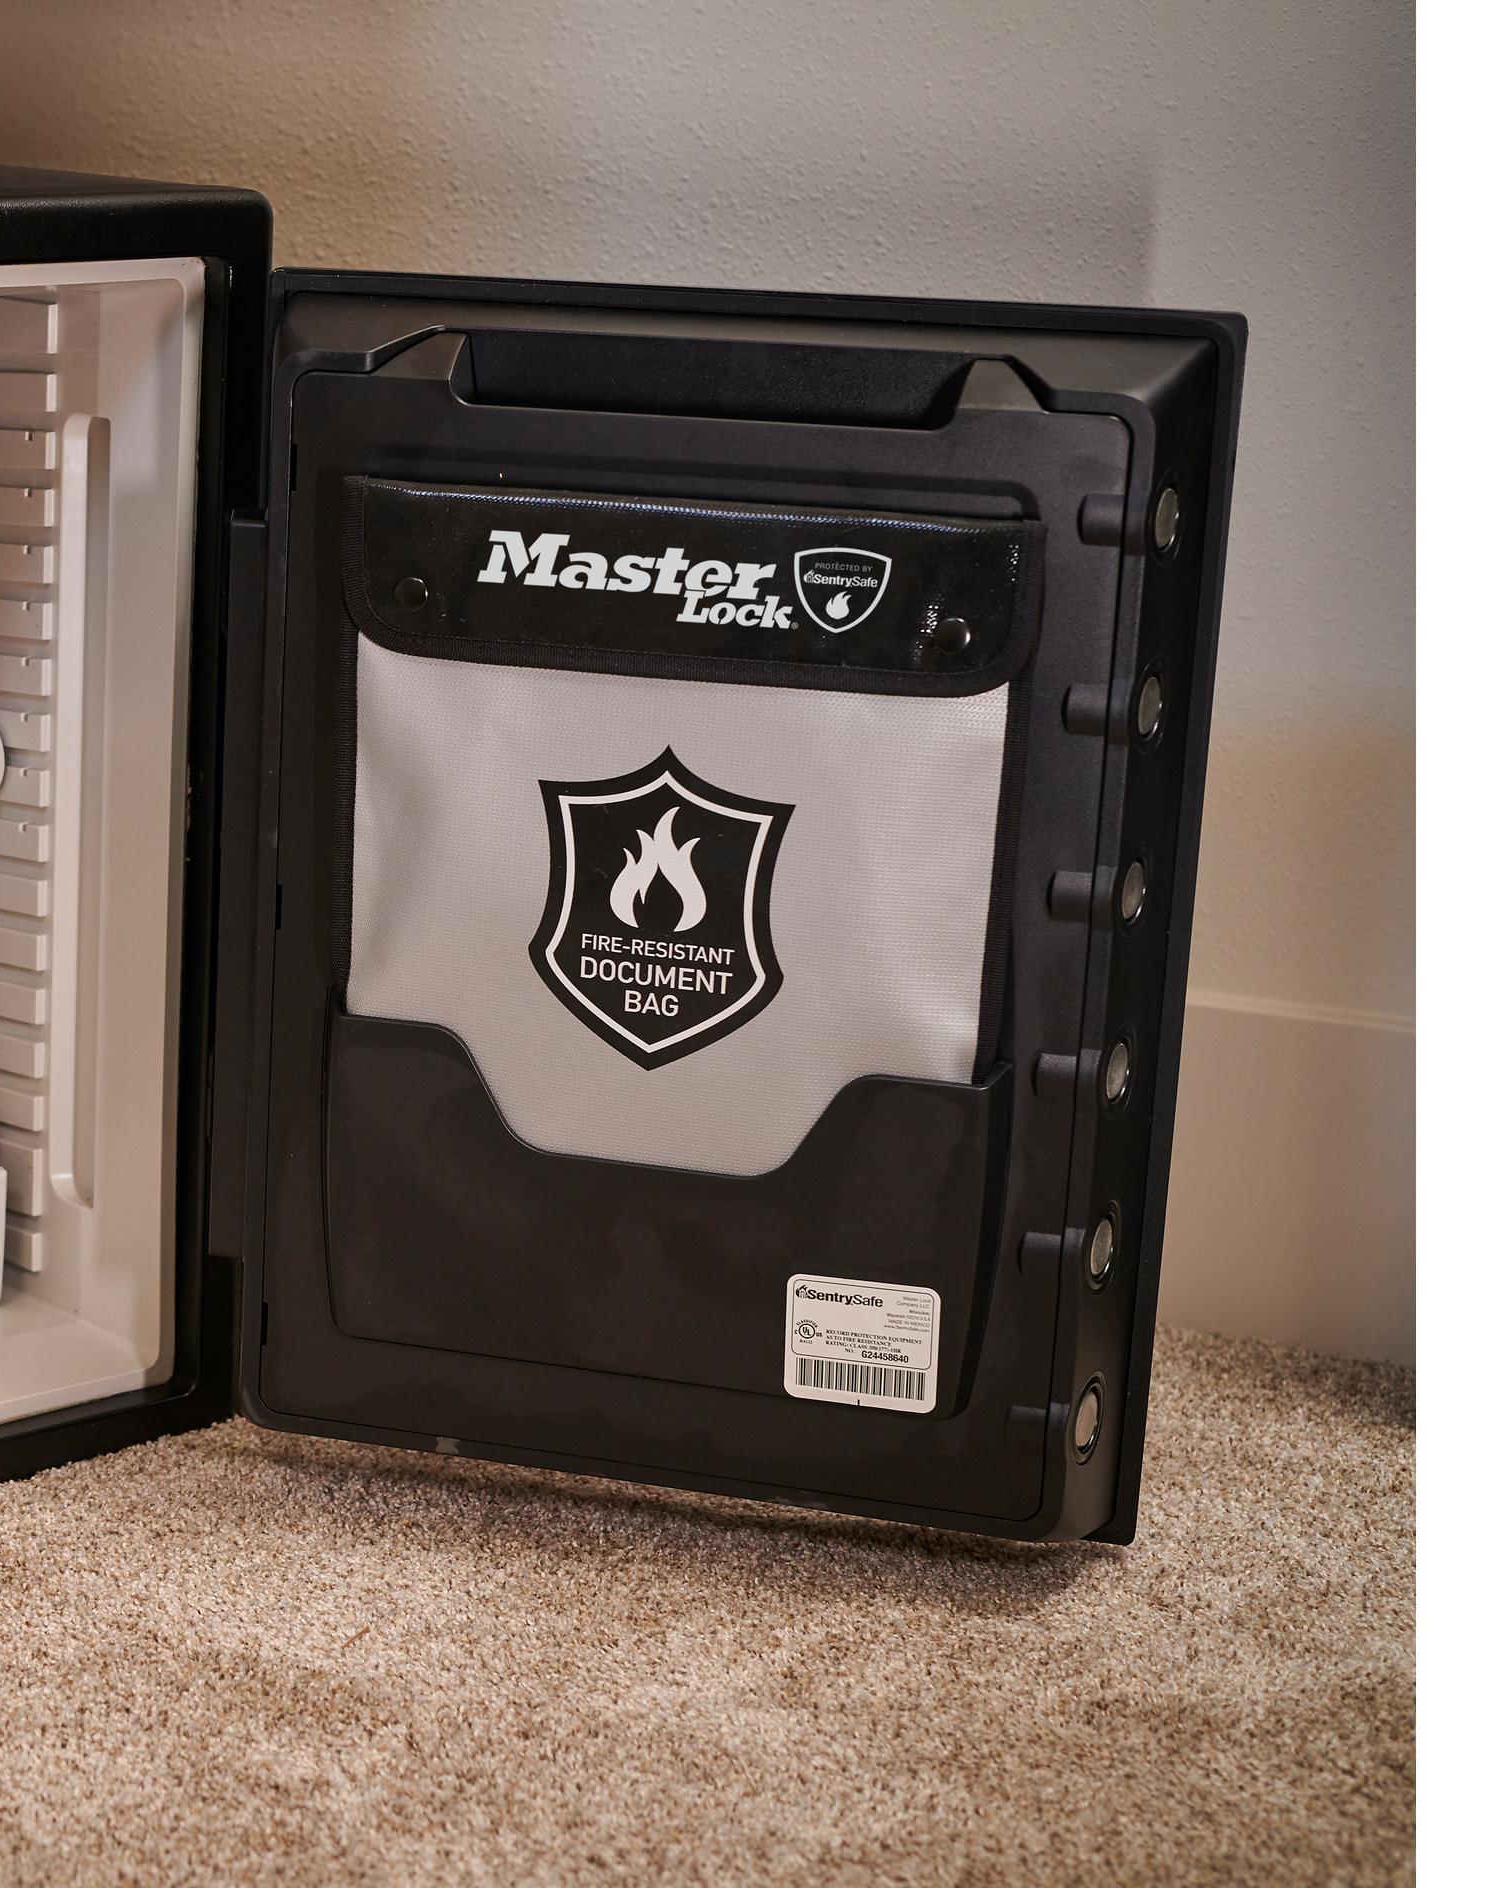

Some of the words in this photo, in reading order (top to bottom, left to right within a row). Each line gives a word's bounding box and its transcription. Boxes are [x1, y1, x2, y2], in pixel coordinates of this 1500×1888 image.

[477, 530, 777, 597] Master
[815, 562, 860, 572] PROTECTED
[814, 573, 878, 588] SentrySafe
[581, 933, 735, 965] FIRE-RESISTANT
[580, 955, 733, 995] DOCUMENT
[624, 989, 679, 1017] BAG
[807, 1288, 884, 1307] SentrySafe
[825, 1329, 850, 1337] RECORD
[850, 1331, 887, 1341] PROTECTION
[888, 1336, 922, 1345] EQUIPMENT
[857, 1338, 892, 1347] RESISTANCE
[861, 1349, 909, 1364] G24458640
